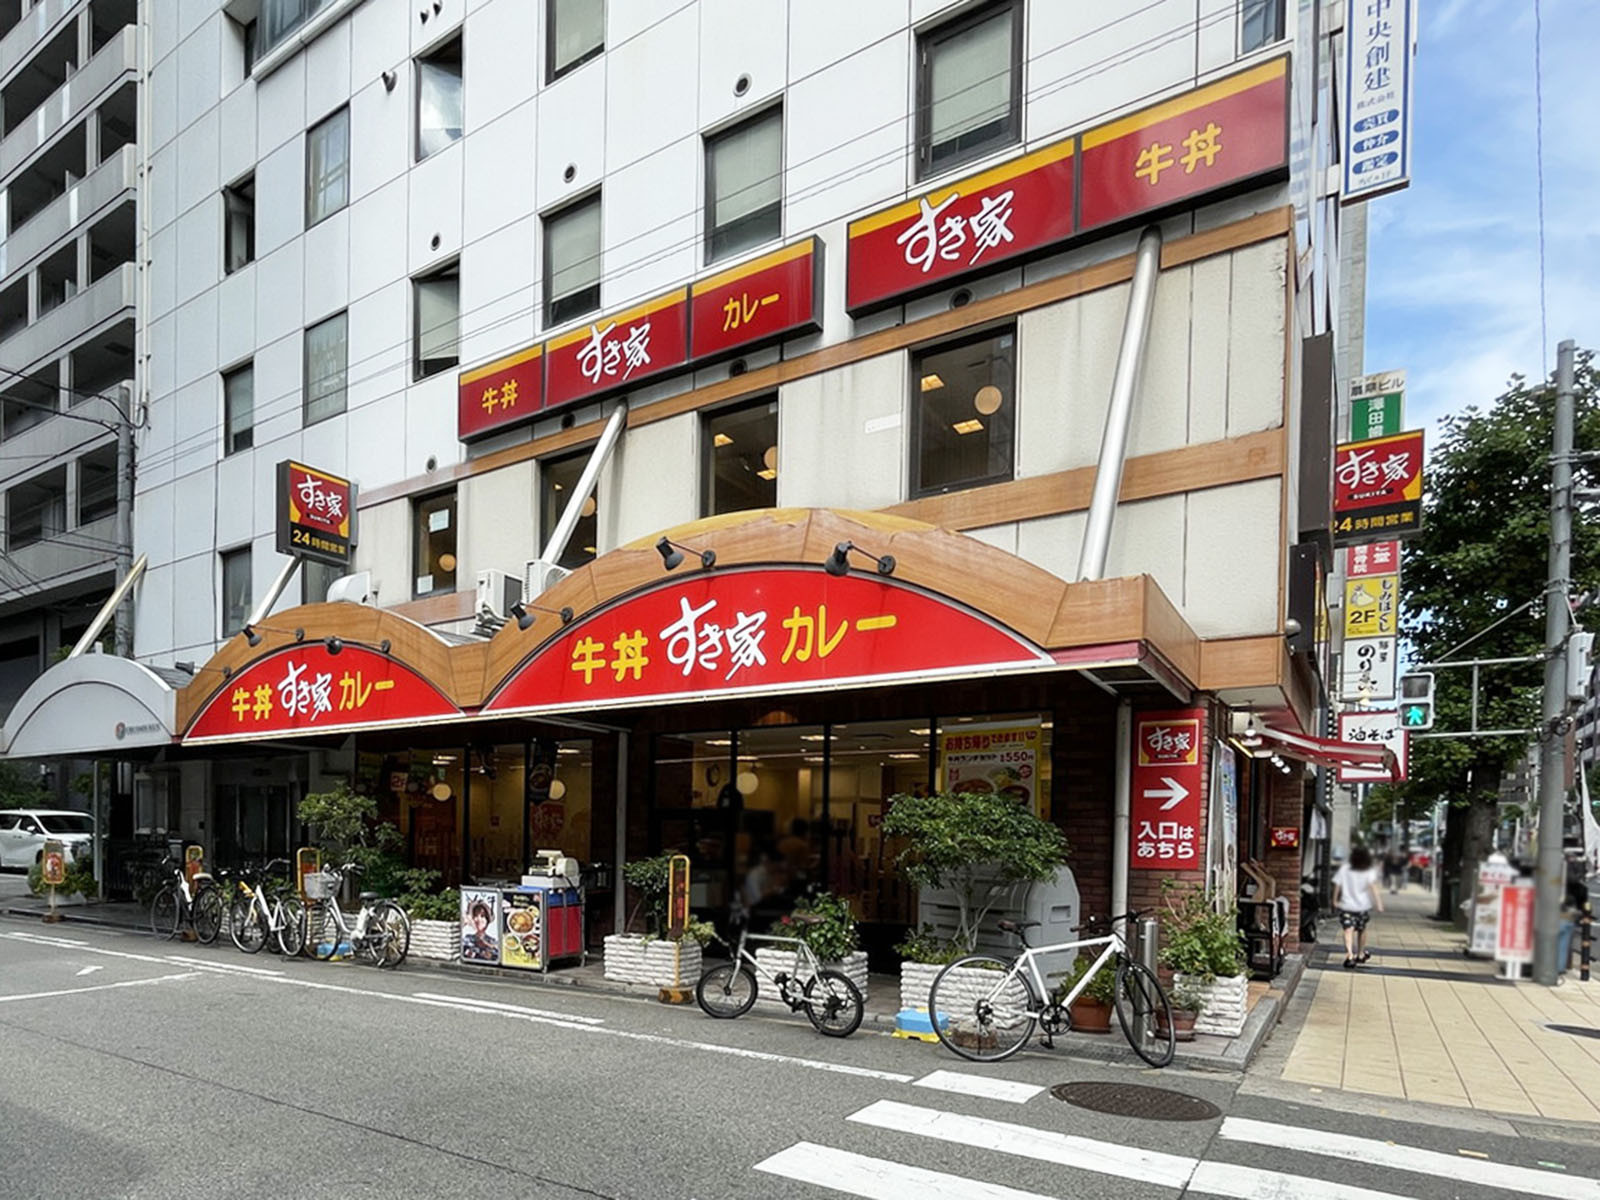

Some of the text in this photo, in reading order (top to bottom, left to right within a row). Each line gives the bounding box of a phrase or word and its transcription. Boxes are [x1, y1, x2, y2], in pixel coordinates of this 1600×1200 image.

[1363, 0, 1392, 93] 中央創建
[897, 121, 1224, 272] すき家 牛丼
[481, 293, 780, 415] 牛丼 すき家 カレー
[1336, 450, 1410, 489] すき家
[297, 474, 343, 518] すき家
[1350, 609, 1376, 625] 2F
[571, 596, 897, 685] 牛丼 すき家 カレー
[231, 660, 395, 722] 牛丼 すき家 カレー
[1147, 727, 1191, 753] すき家
[1348, 726, 1397, 742] 油そば
[1137, 821, 1194, 840] 入口は
[1137, 841, 1195, 859] あちら
